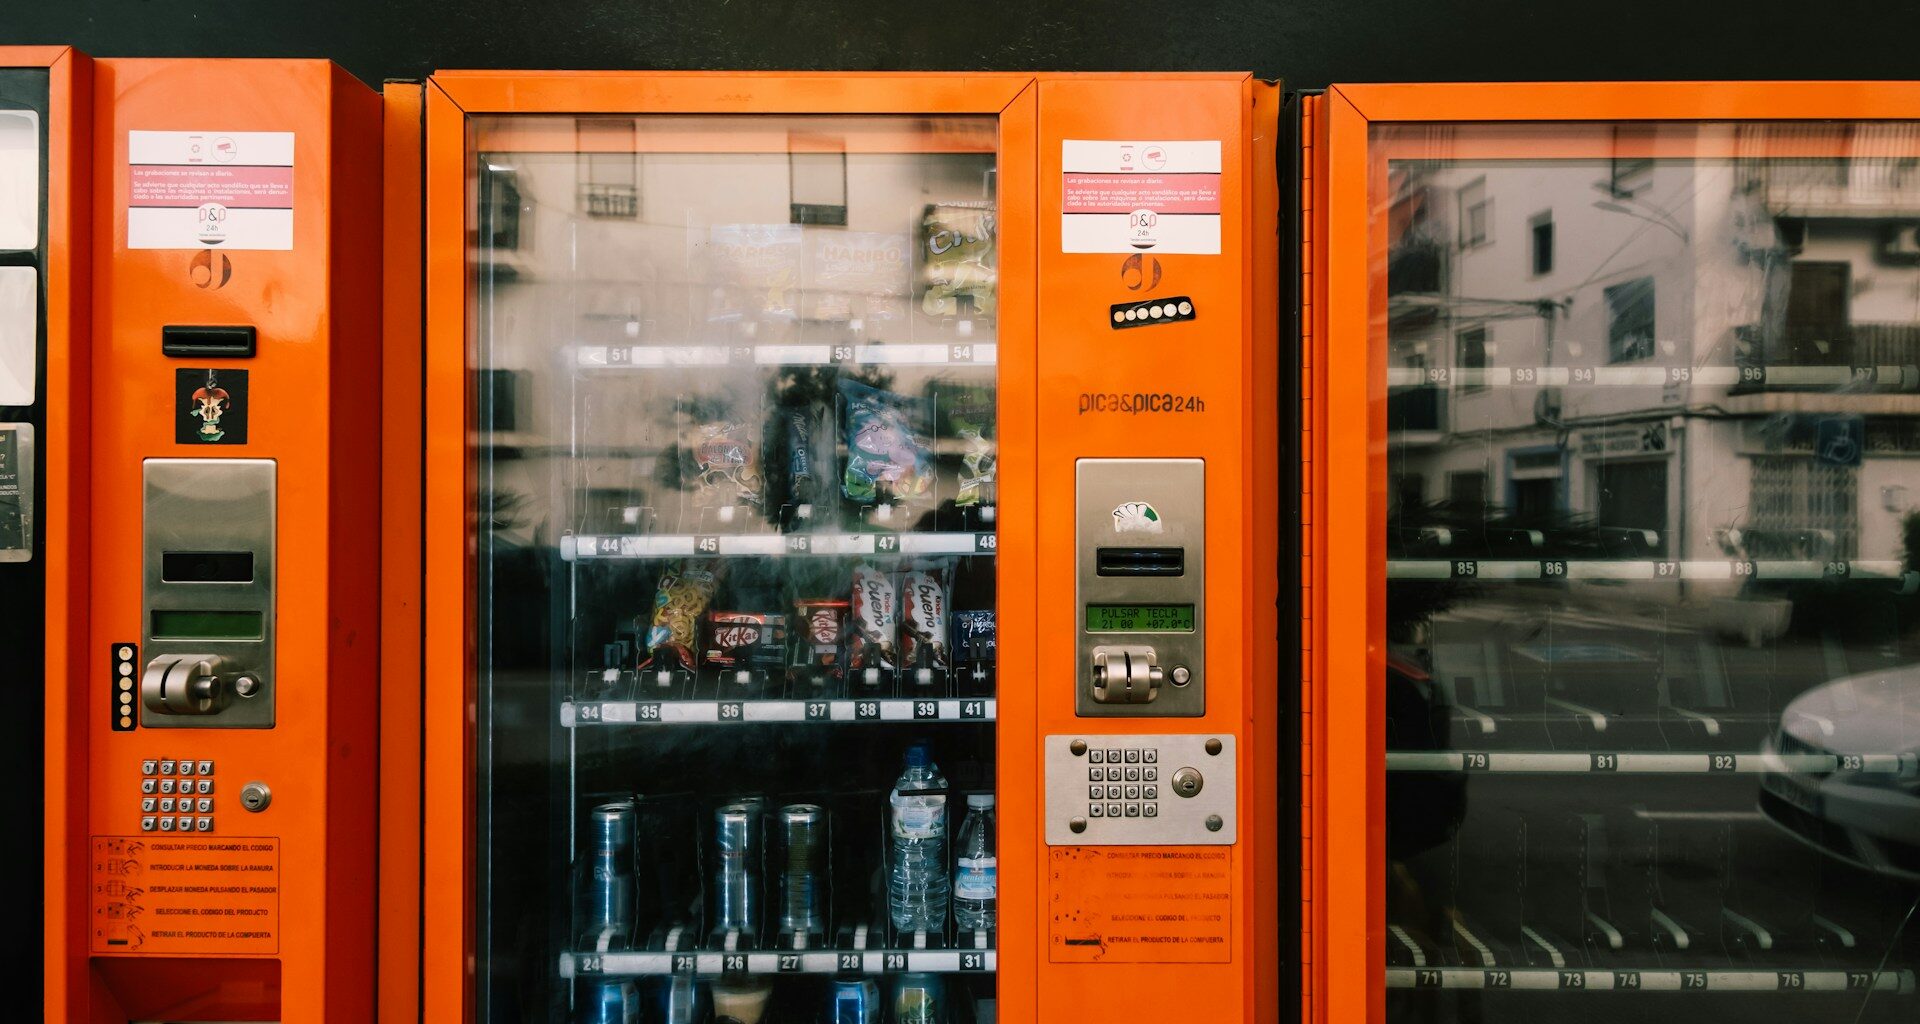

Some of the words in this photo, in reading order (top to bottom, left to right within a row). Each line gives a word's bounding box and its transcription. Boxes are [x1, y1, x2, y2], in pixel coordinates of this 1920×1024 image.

[206, 224, 219, 232] 24h
[823, 244, 900, 264] HARIBO
[612, 347, 628, 361] 51
[835, 346, 851, 361] 53
[953, 346, 970, 359] 54
[1430, 368, 1447, 381] 92
[1516, 368, 1534, 381] 93
[1574, 368, 1592, 381] 94
[1671, 368, 1689, 381] 95
[1744, 368, 1762, 381] 96
[601, 539, 619, 552] 44
[699, 538, 717, 551] 45
[790, 537, 807, 550] 46
[878, 536, 896, 550] 47
[979, 535, 996, 549] 48
[1457, 562, 1475, 575] 85
[1545, 562, 1563, 575] 86
[1658, 562, 1676, 575] 87
[1735, 562, 1753, 575] 88
[867, 579, 885, 627] bueno
[918, 584, 936, 628] bueno
[1101, 608, 1140, 619] PULSAR
[1146, 608, 1178, 619] TECLA
[1102, 619, 1114, 630] 21
[1120, 619, 1134, 630] 00
[581, 706, 599, 719] 34
[641, 705, 658, 719] 35
[722, 704, 739, 718] 36
[809, 703, 827, 717] 37
[859, 703, 877, 717] 38
[917, 702, 935, 716] 39
[965, 702, 981, 716] 41
[1468, 754, 1486, 768] 79
[1597, 755, 1614, 769] 81
[1715, 755, 1732, 769] 82
[1843, 755, 1861, 769] 83
[185, 864, 193, 872] LA
[194, 864, 219, 872] MONEDA
[219, 864, 240, 872] SOBRE
[240, 864, 249, 872] LA
[177, 931, 185, 939] EL
[185, 931, 218, 939] PRODUCTO
[217, 931, 226, 939] DE
[226, 931, 235, 939] LA
[235, 931, 272, 939] COMPUERTA
[583, 957, 600, 971] 24
[677, 956, 694, 970] 25
[727, 956, 744, 970] 26
[781, 956, 799, 970] 27
[842, 955, 859, 969] 28
[887, 955, 904, 969] 29
[964, 954, 981, 968] 31
[1422, 971, 1438, 985] 71
[1490, 972, 1508, 986] 72
[1564, 972, 1582, 987] 73
[1619, 972, 1637, 987] 74
[1686, 973, 1704, 987] 75
[1782, 973, 1800, 987] 76
[1851, 974, 1869, 987] 77
